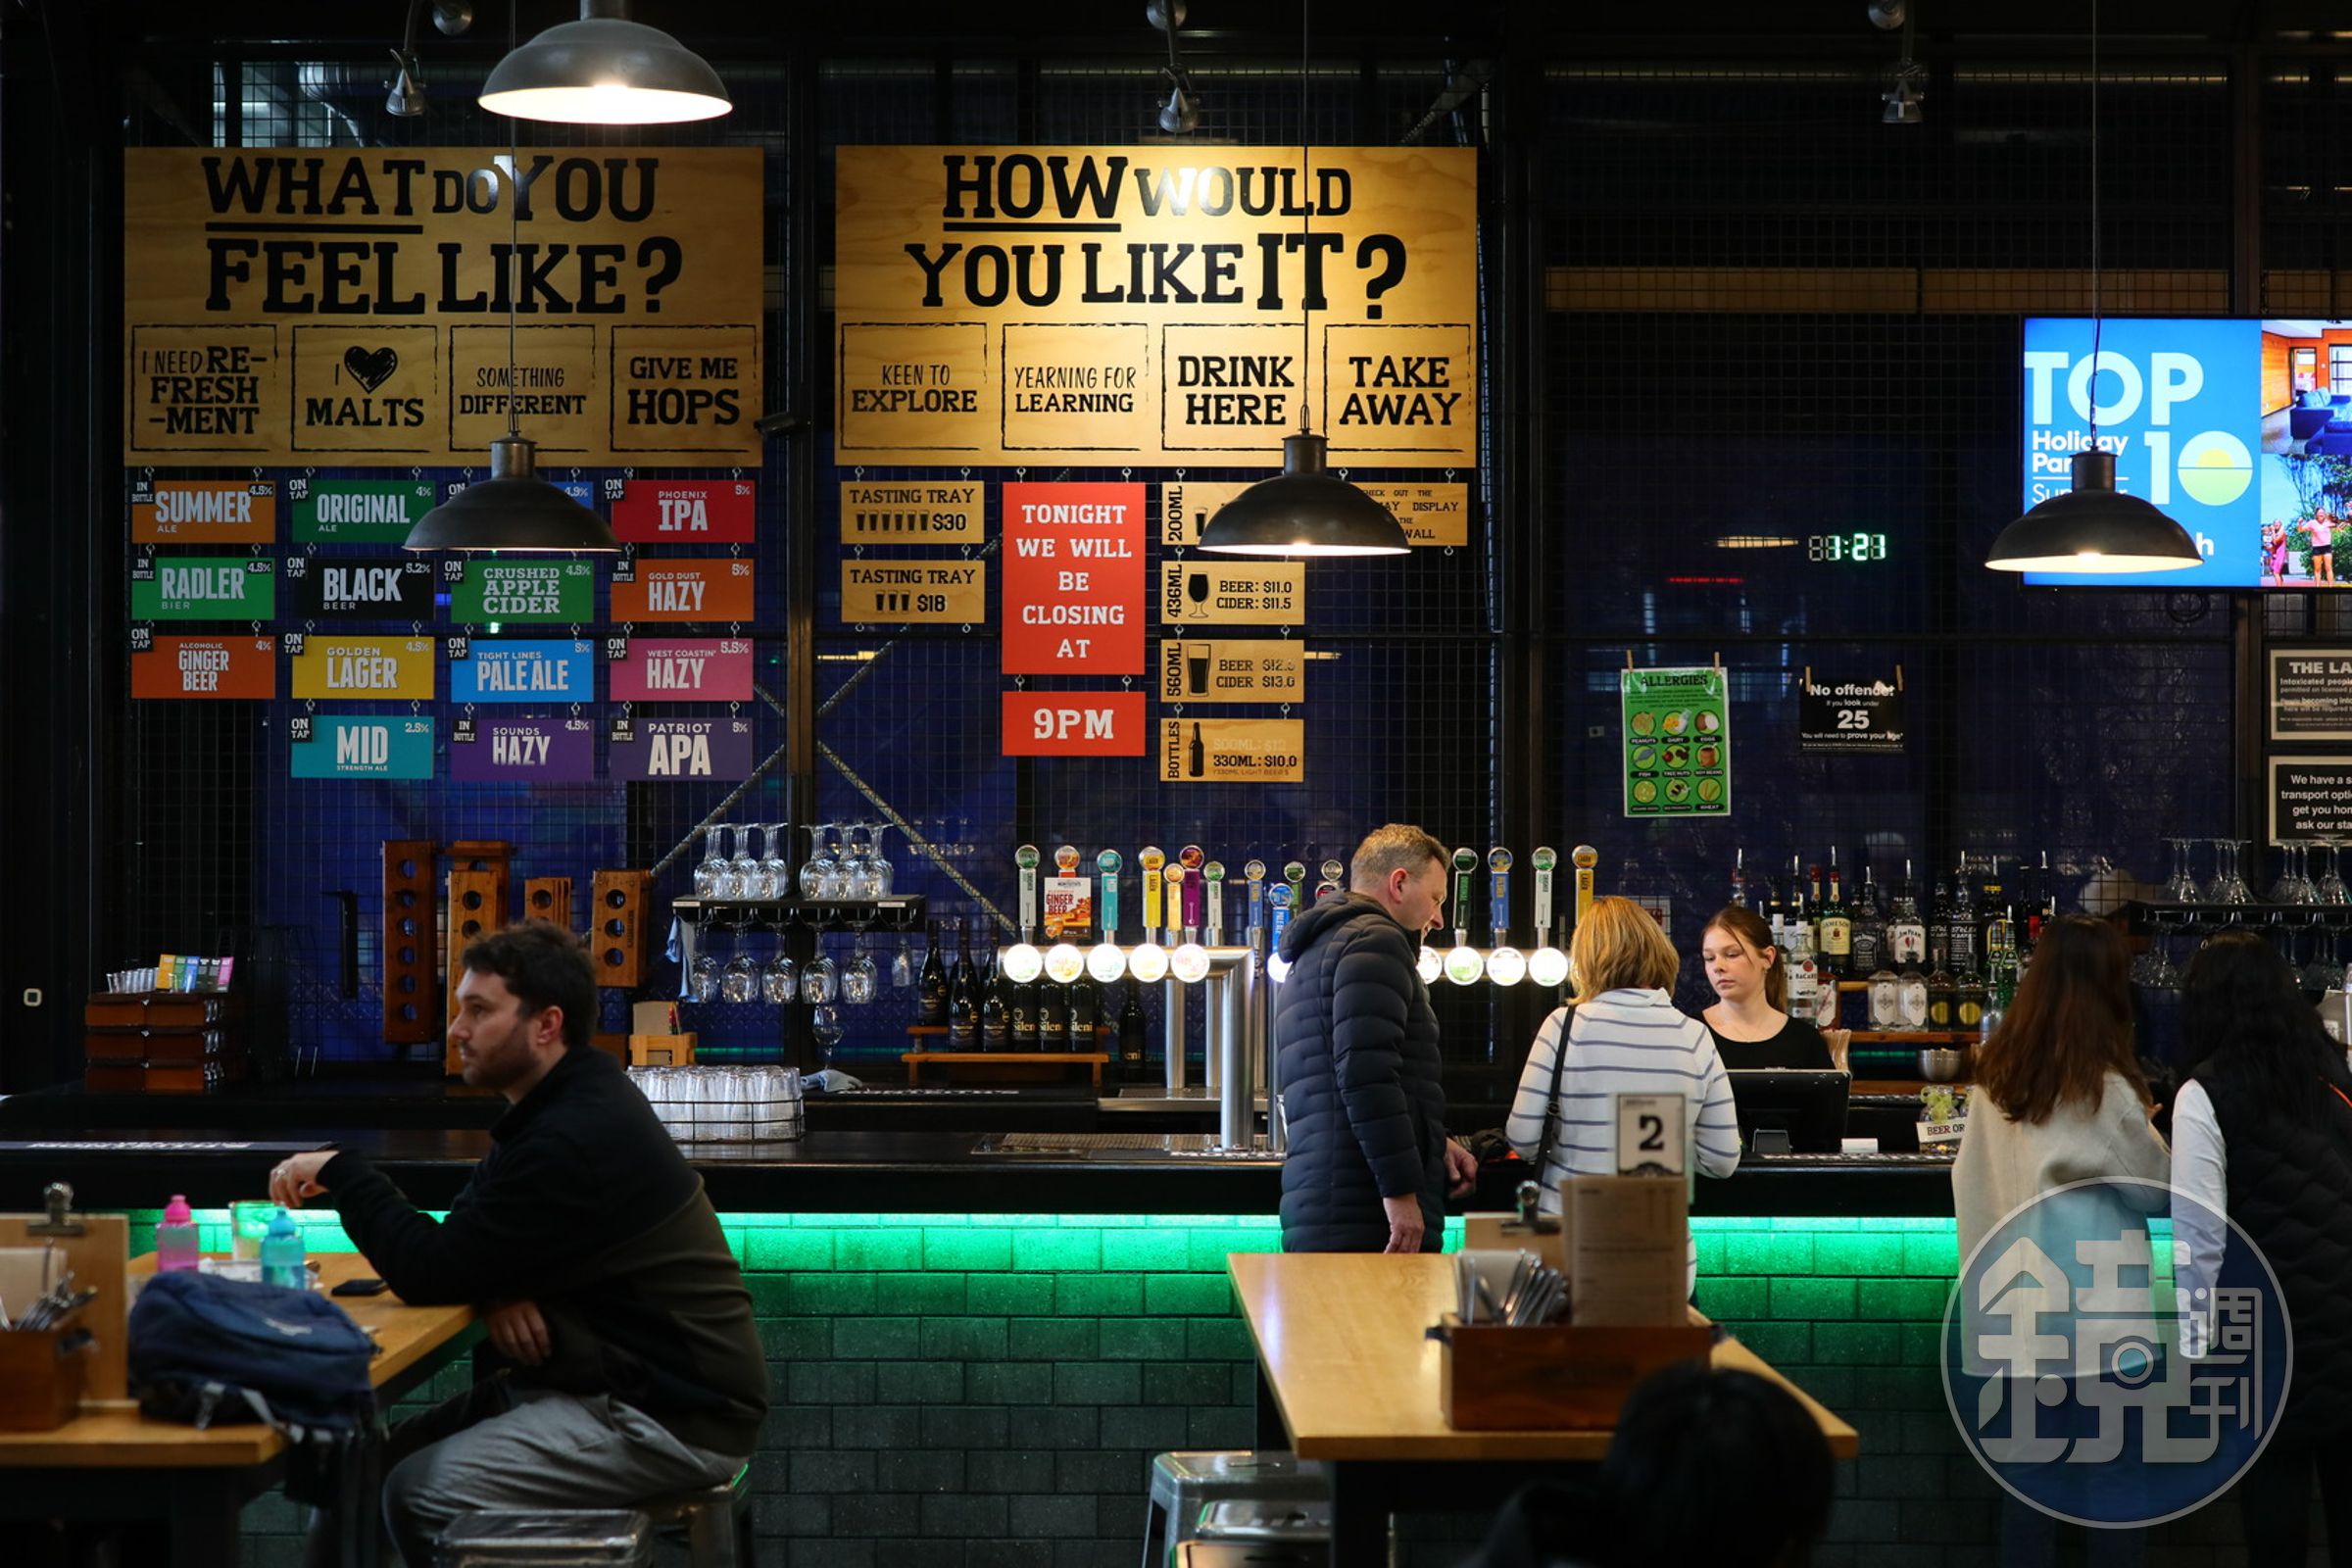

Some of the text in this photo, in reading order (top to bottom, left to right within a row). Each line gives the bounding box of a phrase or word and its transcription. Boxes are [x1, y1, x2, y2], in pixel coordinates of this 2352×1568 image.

[202, 155, 658, 221] WHAT DO YOU
[943, 154, 1351, 219] HOW WOULD
[205, 237, 425, 315] FEEL
[905, 243, 1064, 307] YOU
[1081, 243, 1244, 304] LIKE
[141, 345, 268, 374] I NEED RE-
[334, 365, 339, 386] I
[629, 357, 738, 380] GIVE ME
[882, 365, 951, 387] KEEN TO
[1178, 356, 1295, 388] DRINK
[1349, 356, 1450, 388] TAKE
[476, 367, 565, 389] SOMETHING
[1014, 366, 1137, 390] YEARNING FOR
[150, 376, 260, 405] FRESH
[2025, 351, 2204, 425] TOP
[460, 394, 588, 416] DIFFERENT
[627, 388, 740, 425] HOPS
[852, 389, 977, 414] EXPLORE
[1014, 391, 1135, 413] LEARNING
[1186, 394, 1287, 425] HERE
[1339, 394, 1461, 425] AWAY
[306, 397, 424, 427] MALTS
[149, 407, 261, 435] -MENT
[137, 482, 148, 491] IN
[289, 479, 307, 490] ON
[416, 486, 431, 497] 4%
[605, 478, 623, 491] ON
[735, 484, 751, 495] 5%
[289, 490, 309, 501] TAP
[605, 490, 624, 500] TAP
[849, 488, 975, 504] TASTING TRAY
[155, 491, 252, 523] SUMMER
[317, 494, 411, 523] ORIGINAL
[1021, 505, 1127, 525] TONIGHT
[1168, 486, 1183, 542] 200ML
[1412, 502, 1459, 512] DISPLAY
[659, 500, 708, 531] IPA
[932, 513, 966, 531] $30
[1016, 538, 1132, 558] WE WILL
[137, 559, 149, 568] IN
[287, 558, 305, 568] ON
[406, 563, 431, 573] 5.2%
[444, 561, 463, 572] ON
[617, 561, 629, 571] IN
[732, 564, 750, 576] 5%
[286, 568, 306, 578] TAP
[444, 572, 464, 582] TAP
[483, 567, 561, 579] CRUSHED
[850, 568, 976, 585] TASTING TRAY
[162, 567, 245, 600] RADLER
[323, 567, 403, 602] BLACK
[483, 580, 561, 596] APPLE
[1058, 571, 1090, 592] BE
[1219, 580, 1259, 593] BEER:
[648, 581, 706, 612] HAZY
[1166, 564, 1182, 618] 436ML
[162, 602, 190, 611] BIER
[323, 602, 357, 611] BEER
[483, 597, 561, 614] CIDER
[916, 594, 947, 612] $18
[1216, 597, 1292, 610] CIDER: $11.5
[1022, 606, 1125, 625] CLOSING
[131, 628, 149, 640] ON
[284, 633, 303, 645] ON
[131, 639, 151, 649] TAP
[255, 640, 271, 651] 4%
[284, 645, 304, 655] TAP
[448, 637, 466, 649] ON
[608, 638, 626, 650] ON
[1056, 639, 1091, 659] AT
[327, 647, 381, 657] GOLDEN
[448, 649, 467, 659] TAP
[512, 651, 542, 660] LINES
[607, 649, 627, 660] TAP
[178, 650, 229, 671] GINGER
[1219, 660, 1253, 671] BEER
[2289, 662, 2324, 673] THE
[182, 671, 219, 692] BEER
[327, 658, 398, 689] LAGER
[477, 660, 568, 692] PALE ALE
[647, 659, 705, 689] HAZY
[1216, 675, 1254, 688] CIDER
[1641, 674, 1708, 686] ALLERGIES
[1810, 684, 1831, 696] No
[291, 717, 310, 730] ON
[459, 720, 470, 730] IN
[616, 720, 628, 730] IN
[1034, 709, 1114, 740] 9PM
[1838, 710, 1870, 729] 25
[291, 729, 311, 739] TAP
[493, 727, 540, 736] SOUNDS
[648, 723, 711, 734] PATRIOT
[336, 726, 388, 764] MID
[492, 736, 551, 765] HAZY
[1168, 721, 1180, 778] BOTTLES
[648, 734, 711, 775] APA
[1213, 755, 1297, 767] 330ML: $10.0
[2290, 774, 2308, 784] We
[2309, 774, 2334, 784] have
[2281, 790, 2328, 802] transport
[2292, 806, 2331, 816] get you
[2295, 820, 2315, 830] ask
[1046, 894, 1074, 906] GINGER
[1639, 1114, 1664, 1151] 2
